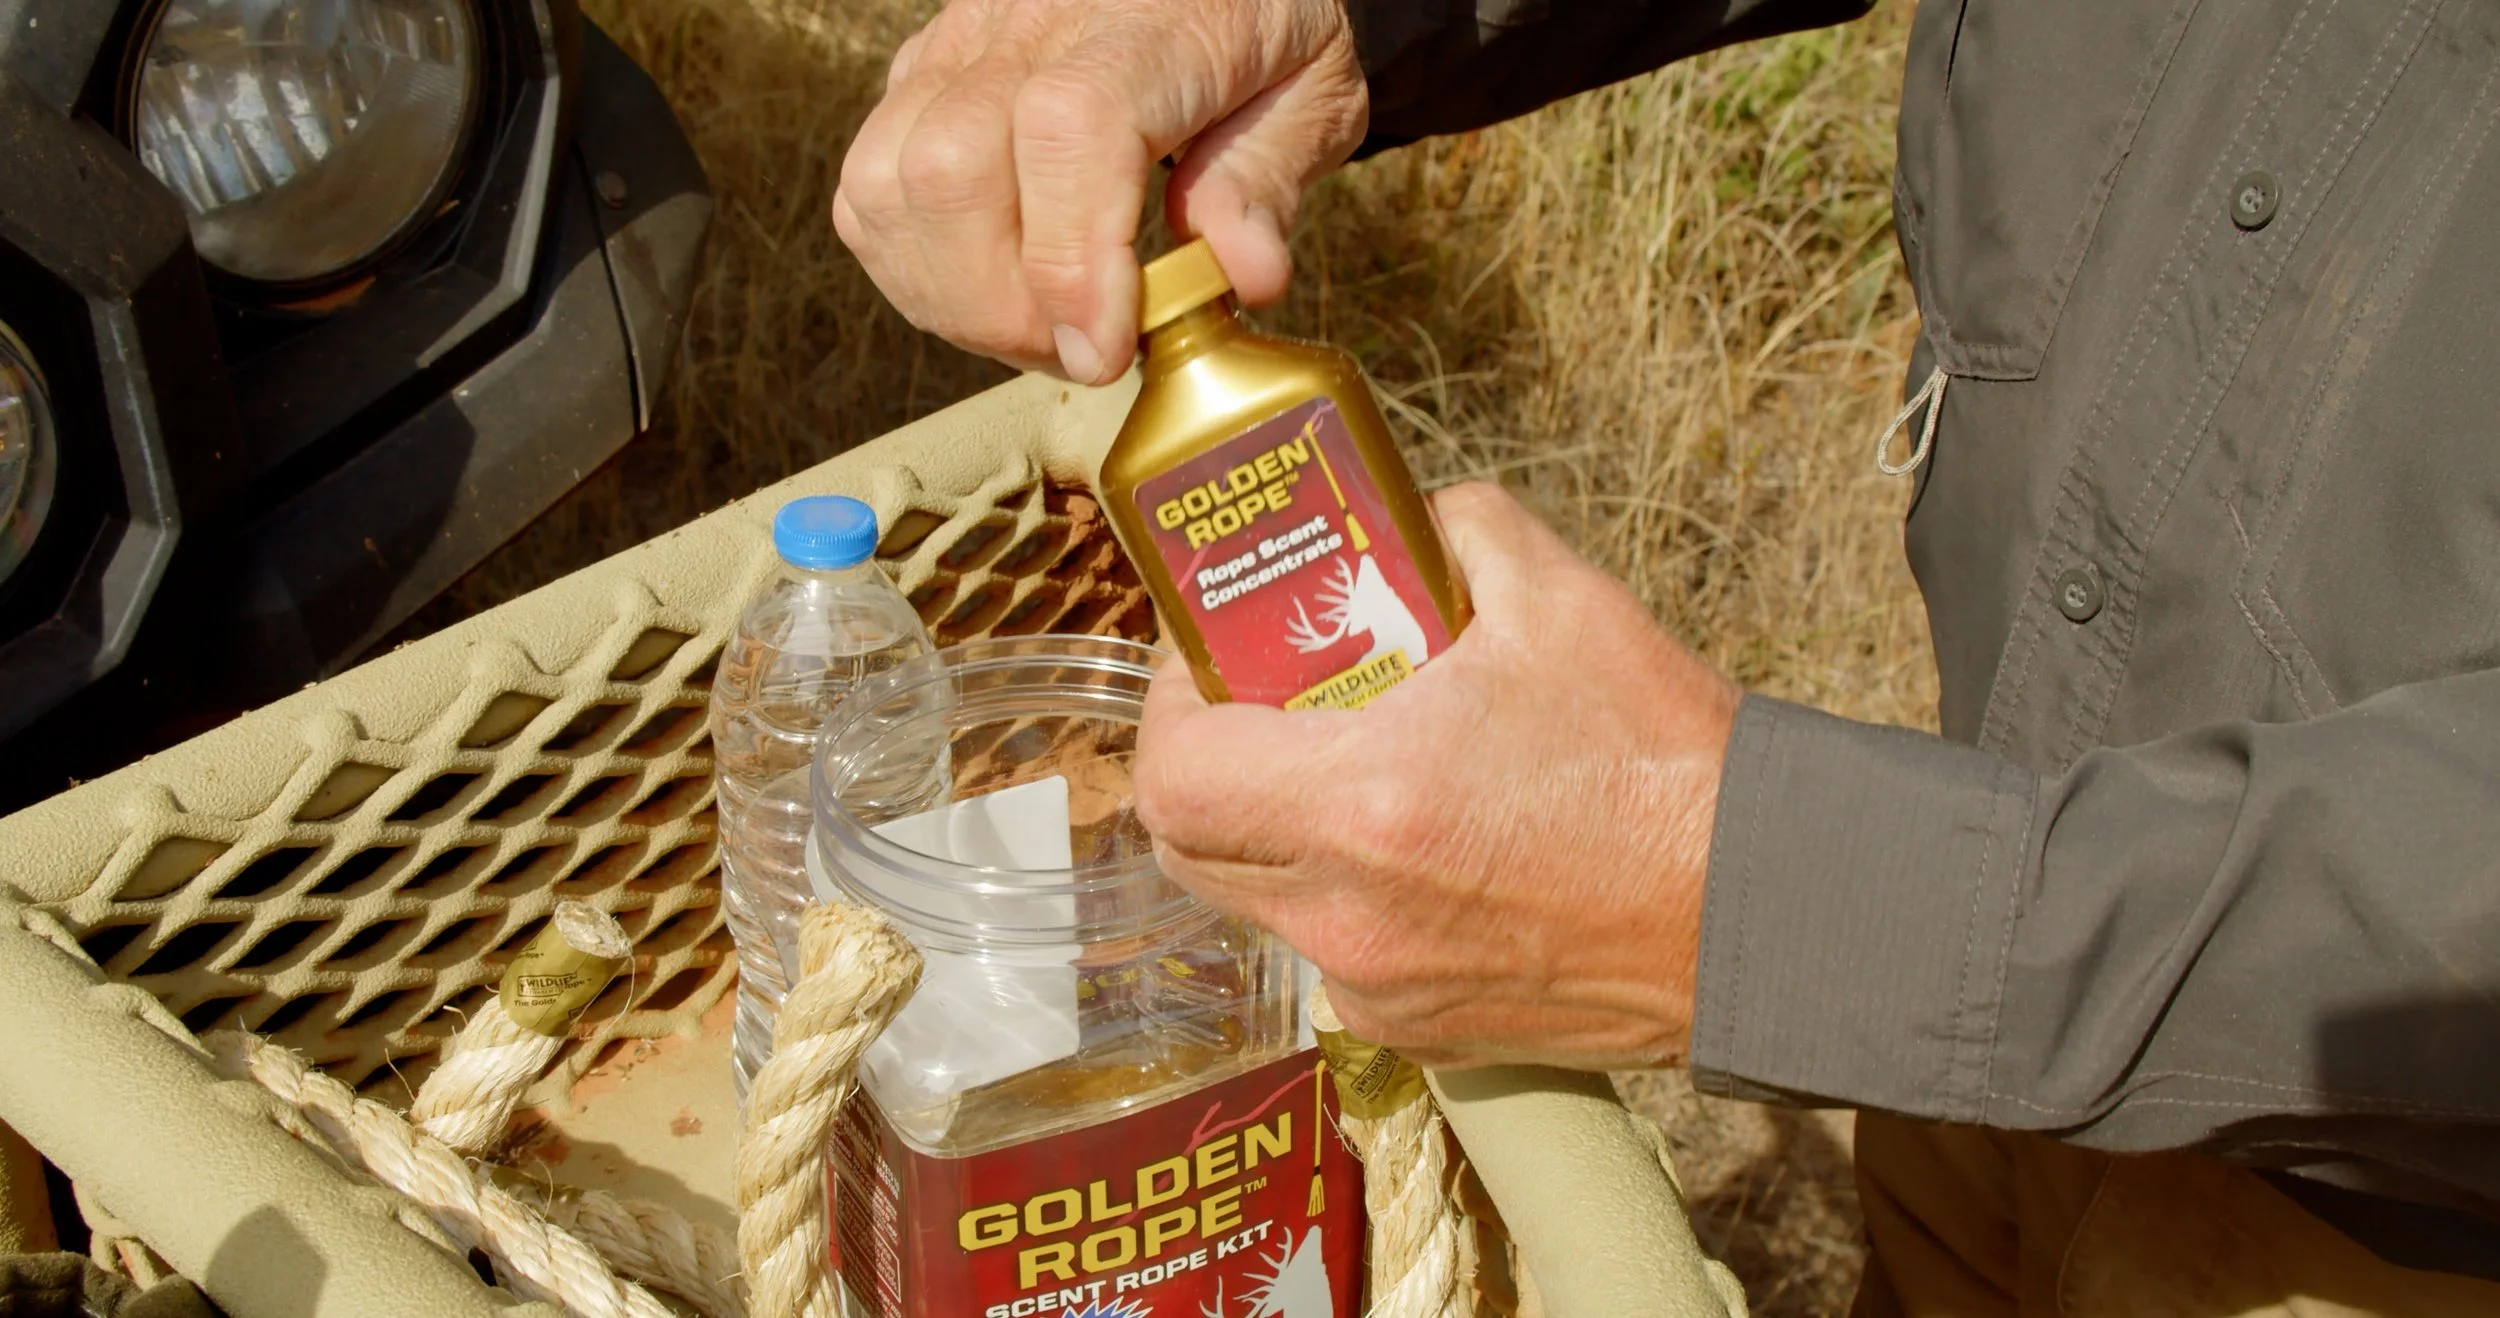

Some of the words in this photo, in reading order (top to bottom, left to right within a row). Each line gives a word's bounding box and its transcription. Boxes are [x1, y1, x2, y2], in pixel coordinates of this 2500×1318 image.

[1156, 438, 1310, 531] GOLDEN
[1197, 550, 1257, 590] Rope
[1258, 514, 1329, 558] Scent
[1201, 532, 1344, 611] Concentrate
[1306, 653, 1403, 708] WILDLIFE
[531, 998, 557, 1007] Gold
[958, 1111, 1292, 1251] GOLDEN
[986, 1280, 1107, 1318] SCENT
[1116, 1248, 1208, 1293] ROPE
[1217, 1219, 1274, 1260] KIT
